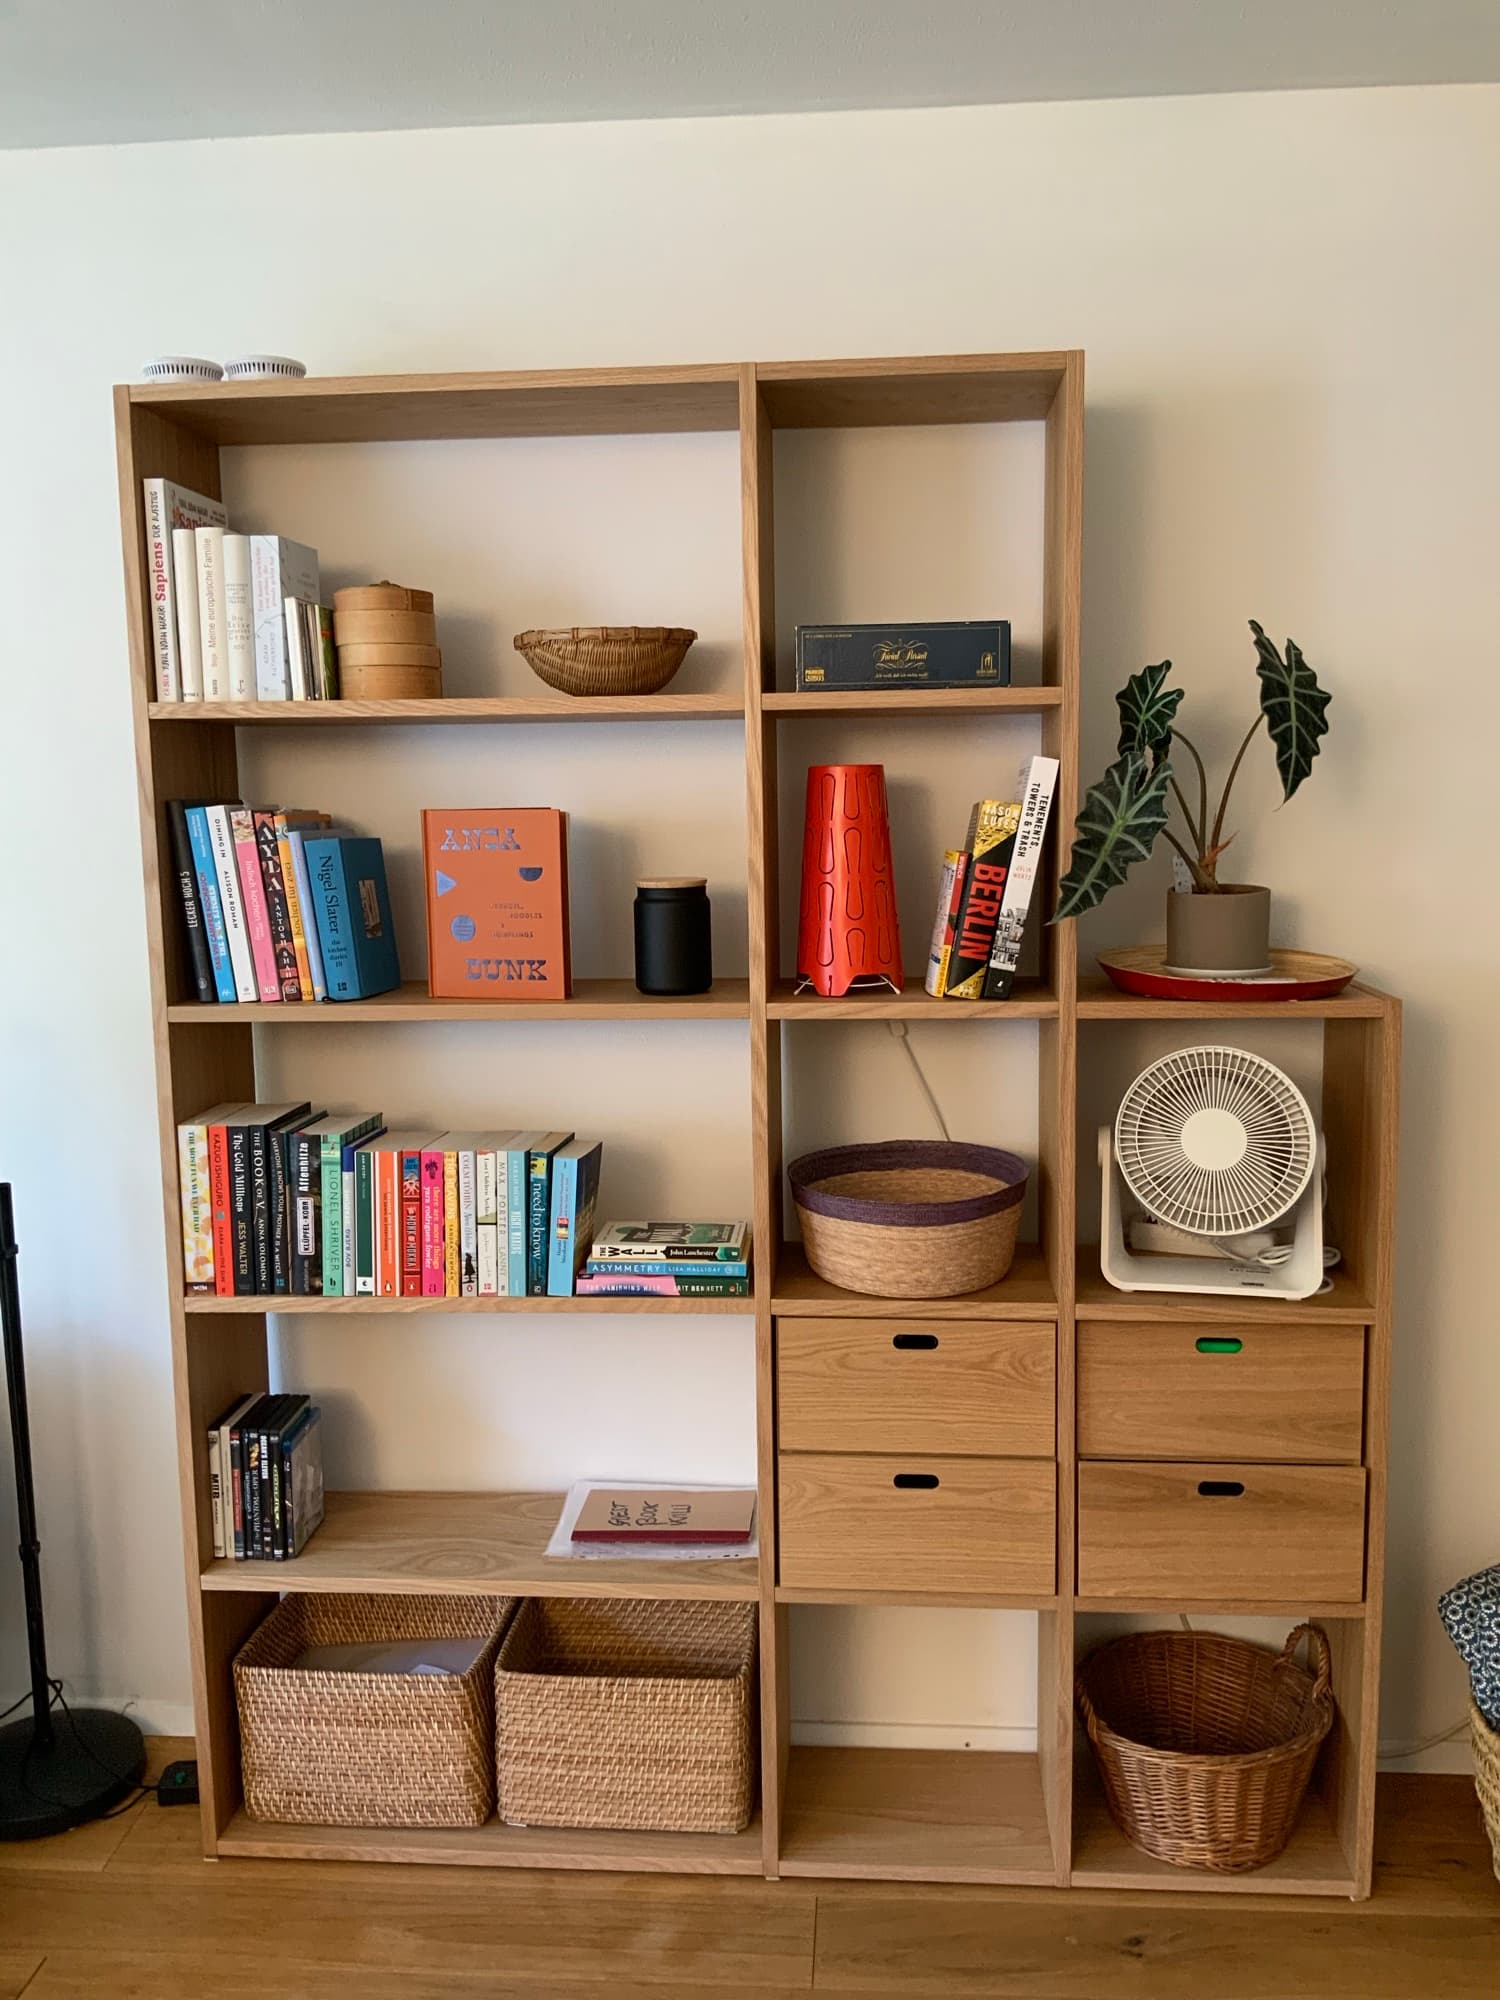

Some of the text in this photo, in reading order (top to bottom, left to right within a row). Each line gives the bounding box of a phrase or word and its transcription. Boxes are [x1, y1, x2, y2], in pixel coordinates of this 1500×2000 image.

[152, 525, 161, 538] DER
[153, 542, 168, 601] Sapiens
[203, 538, 217, 648] Meine europäische Familie
[159, 606, 167, 630] HARARI
[1026, 782, 1041, 818] TOWERS
[215, 819, 224, 847] DINING
[1031, 796, 1050, 849] TENEMENTS,
[260, 827, 282, 891] AYLA
[1017, 829, 1030, 858] TRASH
[285, 862, 294, 883] zwei
[180, 871, 199, 928] LECKER HOCH 5
[224, 871, 239, 929] ALISON ROMAN
[246, 861, 256, 889] Indisch
[251, 890, 261, 922] kochen
[317, 856, 340, 935] Nigel Slater
[274, 897, 288, 947] SANTOSH
[291, 903, 302, 936] Kochen
[958, 863, 1007, 961] BERLIN
[465, 959, 548, 981] DUNK
[213, 1134, 224, 1207] KAZUO ISHIGURO
[254, 1150, 264, 1187] BOOK
[272, 1138, 281, 1169] EVERYONE
[299, 1143, 309, 1192] Affenhitze
[233, 1134, 245, 1213] The Cold Millions
[533, 1184, 545, 1211] need
[329, 1170, 340, 1272] LIONEL SHRIVER
[407, 1215, 417, 1235] MONK
[424, 1206, 432, 1243] rodrigues
[533, 1213, 544, 1226] to
[238, 1221, 248, 1275] JESS WALTER
[302, 1223, 311, 1252] KLÜPFEL
[407, 1242, 417, 1267] MOKHA
[533, 1228, 544, 1260] know
[608, 1247, 658, 1257] WALL
[670, 1249, 684, 1257] John
[432, 1246, 441, 1270] things
[592, 1264, 661, 1273] ASYMMETRY
